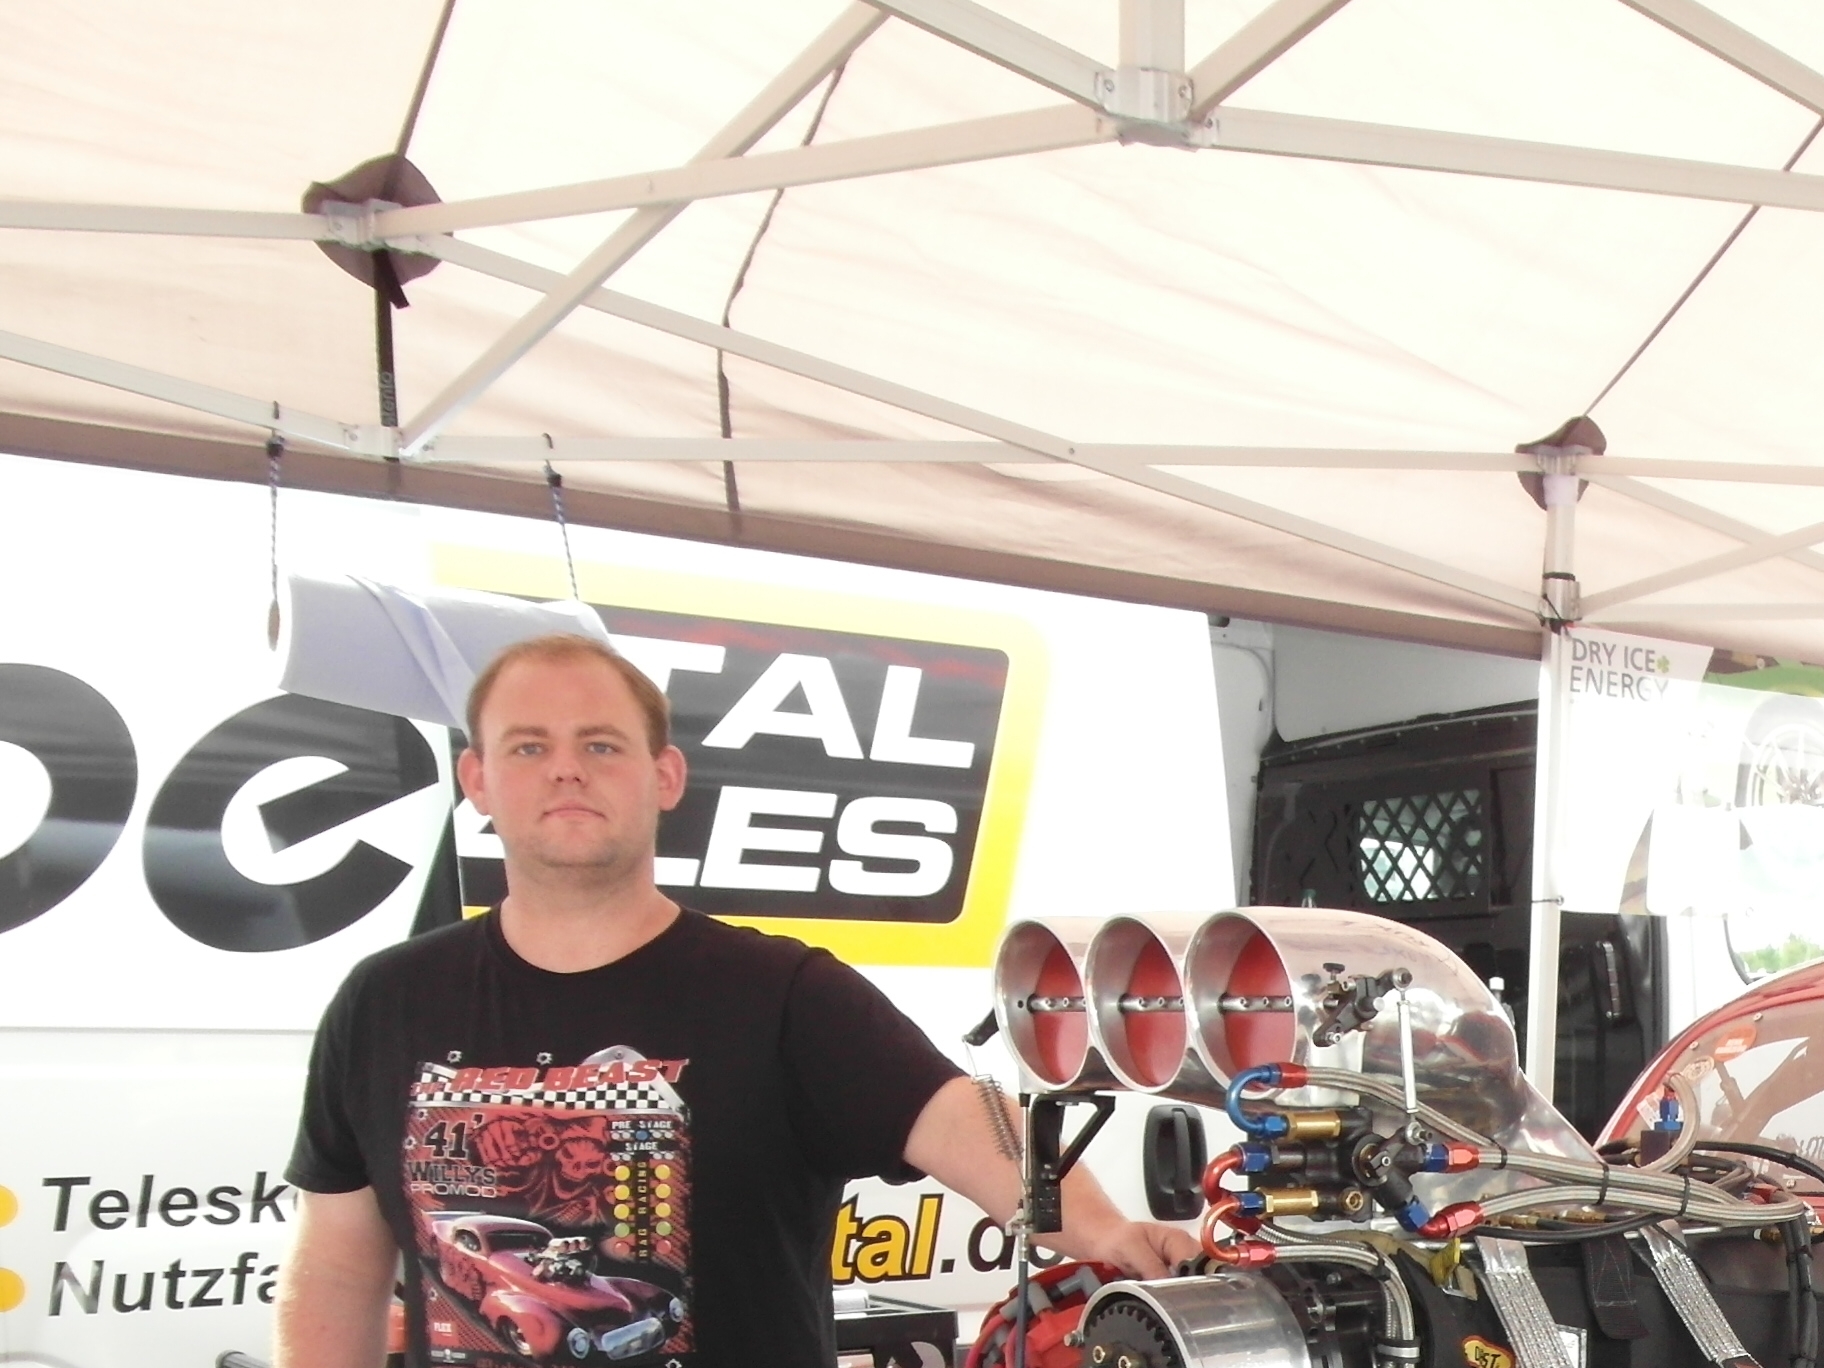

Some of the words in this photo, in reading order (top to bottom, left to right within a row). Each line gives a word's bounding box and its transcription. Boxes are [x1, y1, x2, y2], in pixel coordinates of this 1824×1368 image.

[1571, 637, 1617, 667] DRY
[1623, 645, 1656, 673] ICE
[1570, 665, 1669, 702] ENERGY
[449, 1065, 541, 1092] RED
[543, 1058, 690, 1092] BEAST
[611, 1120, 631, 1130] PRE
[639, 1120, 672, 1130] STAGE
[625, 1141, 659, 1151] STAGE
[405, 1161, 498, 1186] WILLYS
[409, 1182, 498, 1199] PROMOD
